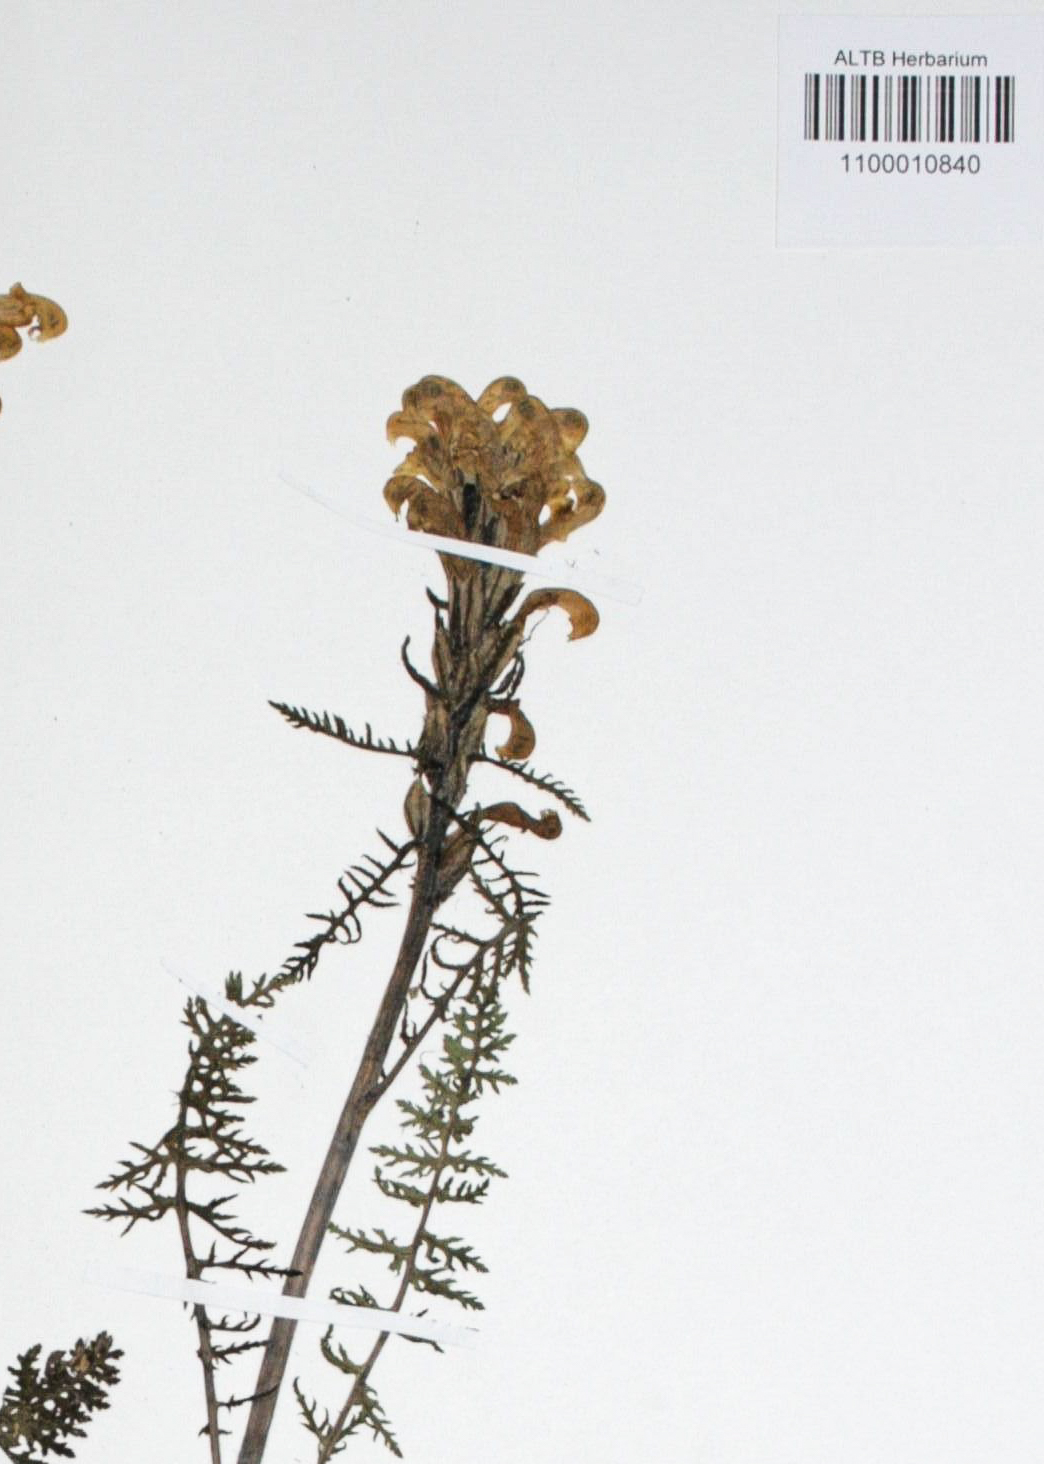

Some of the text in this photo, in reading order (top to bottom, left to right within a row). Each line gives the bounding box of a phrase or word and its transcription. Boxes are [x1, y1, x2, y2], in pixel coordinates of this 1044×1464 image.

[834, 49, 988, 67] ALTB Herbarium
[841, 153, 981, 174] 1100010840
